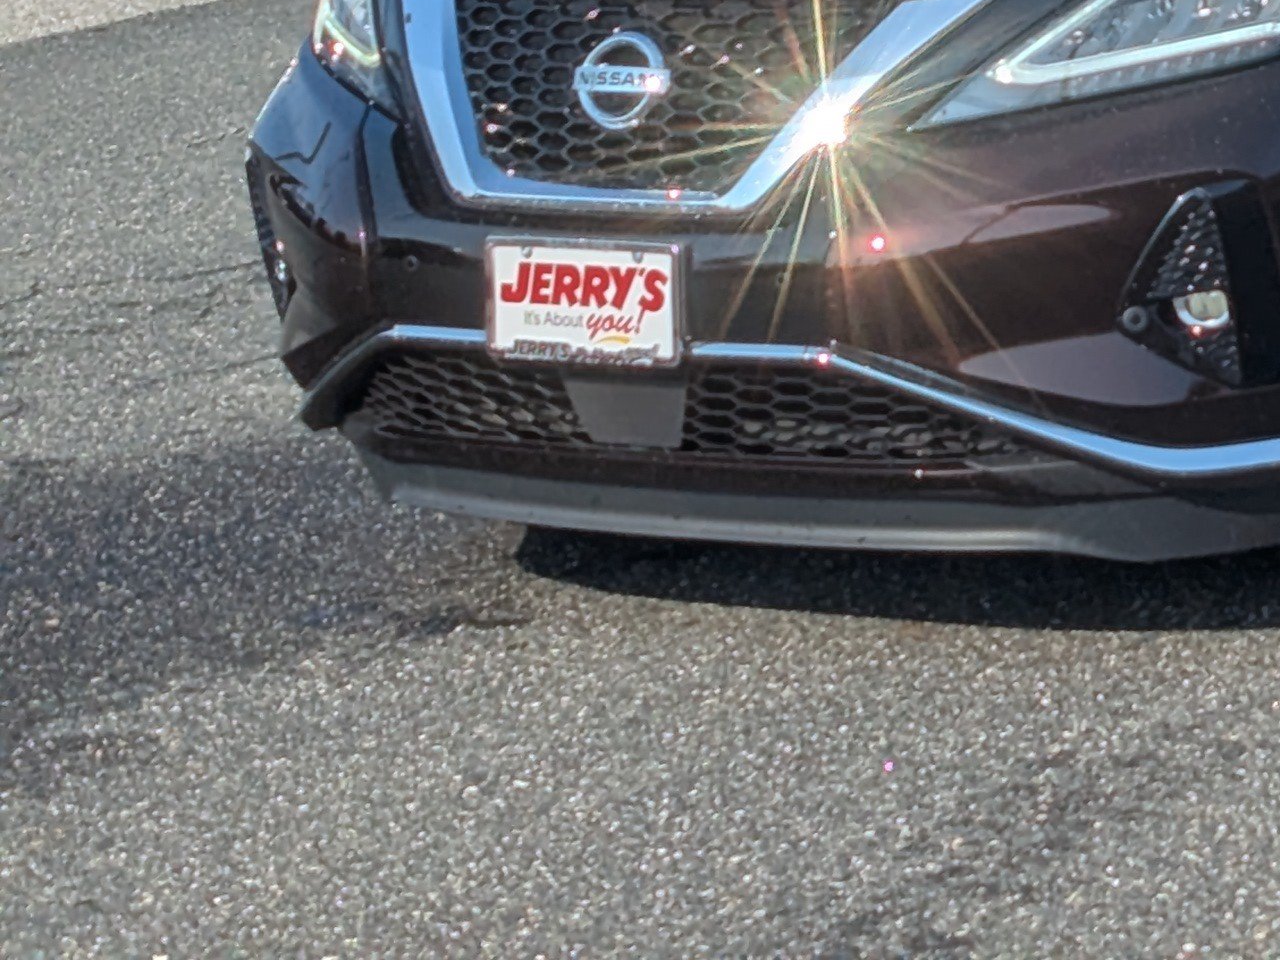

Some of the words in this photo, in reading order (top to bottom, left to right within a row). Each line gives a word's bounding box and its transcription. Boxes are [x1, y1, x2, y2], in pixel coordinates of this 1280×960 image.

[500, 262, 668, 312] JERRY'S
[523, 310, 542, 327] It's
[543, 310, 584, 328] About
[585, 307, 646, 341] you!
